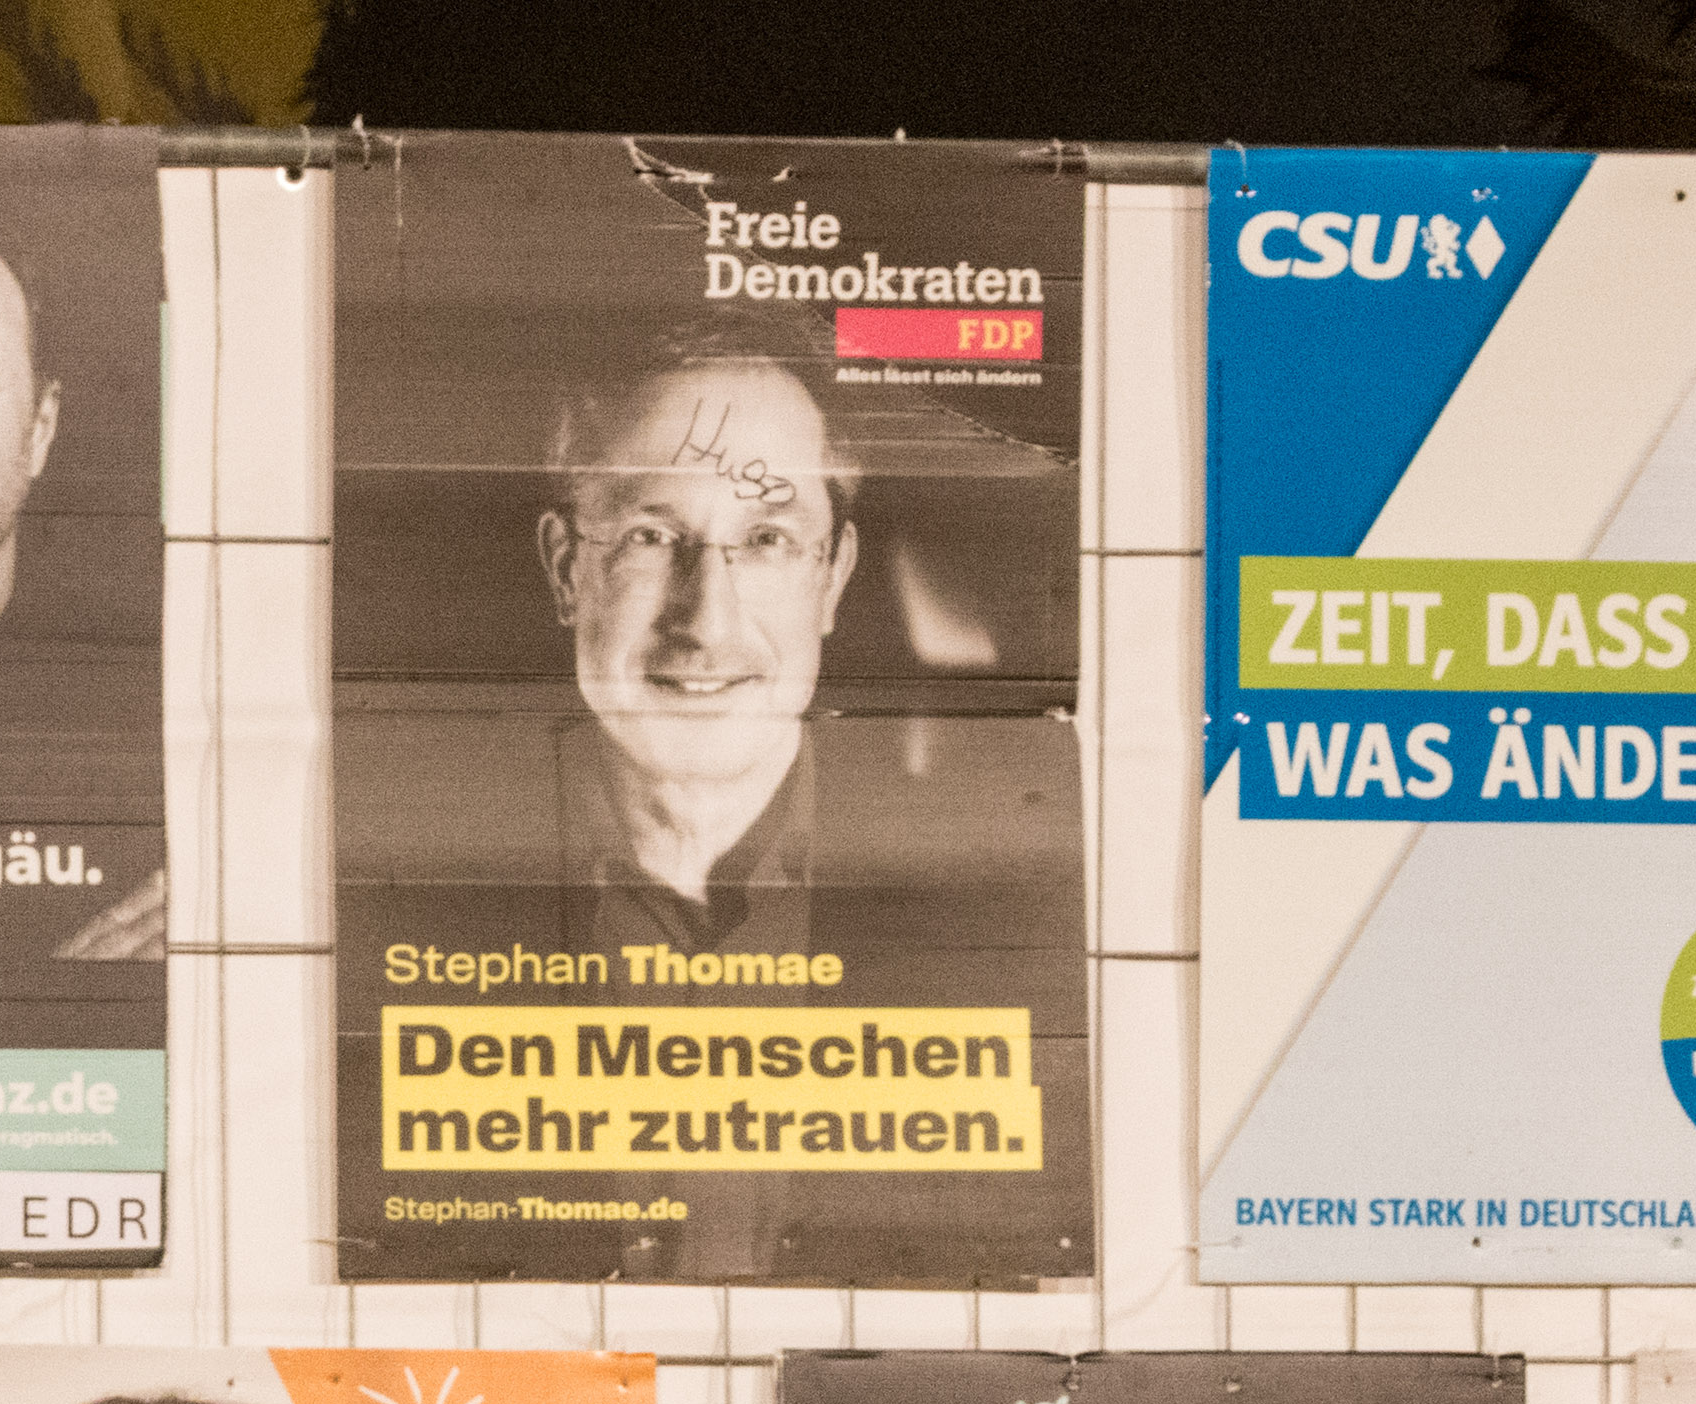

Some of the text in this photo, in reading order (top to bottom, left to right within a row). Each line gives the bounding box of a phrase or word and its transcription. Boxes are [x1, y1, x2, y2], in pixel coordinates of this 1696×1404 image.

[704, 200, 841, 250] Freie
[1237, 211, 1419, 280] CSU
[704, 252, 1044, 302] Demokraten
[957, 319, 1035, 351] FDP
[1267, 590, 1457, 681] ZEIT,
[1486, 592, 1691, 670] DASS
[1265, 720, 1455, 799] WAS
[385, 944, 844, 993] Stephan Thomae
[396, 1023, 1012, 1079] Den Menschen
[396, 1096, 1026, 1153] mehr zutrauen.
[385, 1196, 688, 1225] Stephan-Thomae.de
[1235, 1196, 1358, 1227] BAYERN
[1368, 1197, 1466, 1229] STARK
[1475, 1198, 1508, 1228] IN
